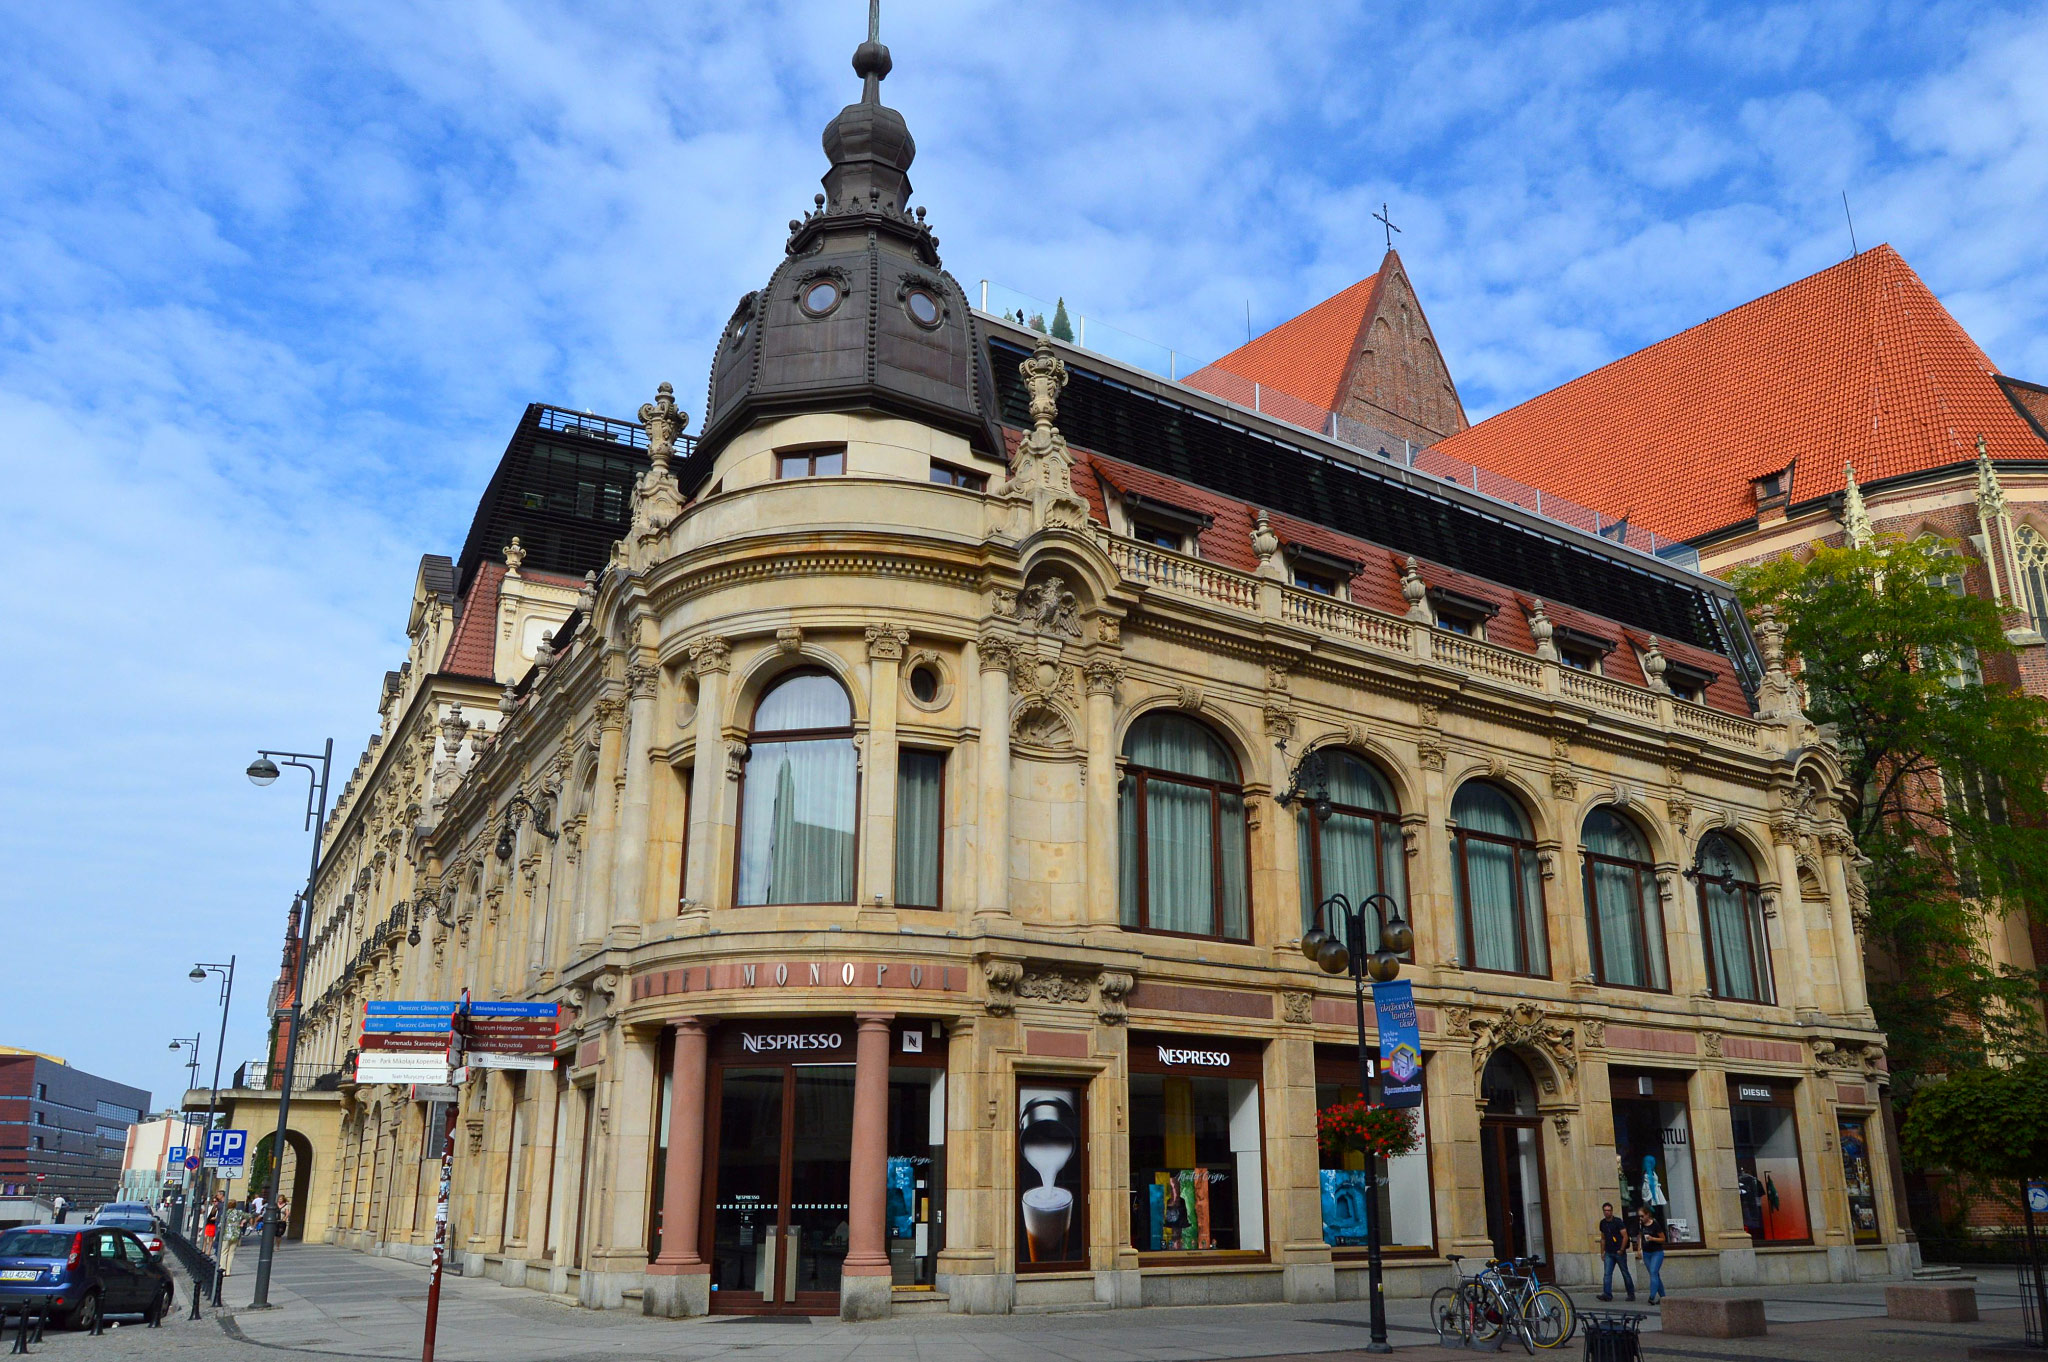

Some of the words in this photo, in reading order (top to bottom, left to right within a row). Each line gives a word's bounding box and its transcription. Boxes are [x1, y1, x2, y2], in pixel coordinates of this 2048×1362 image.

[743, 962, 951, 991] MONOPOL
[741, 1032, 842, 1053] NESPRESSO
[1156, 1045, 1230, 1067] NESPRESSO
[1742, 1088, 1770, 1097] DIESEL
[223, 1133, 243, 1156] P
